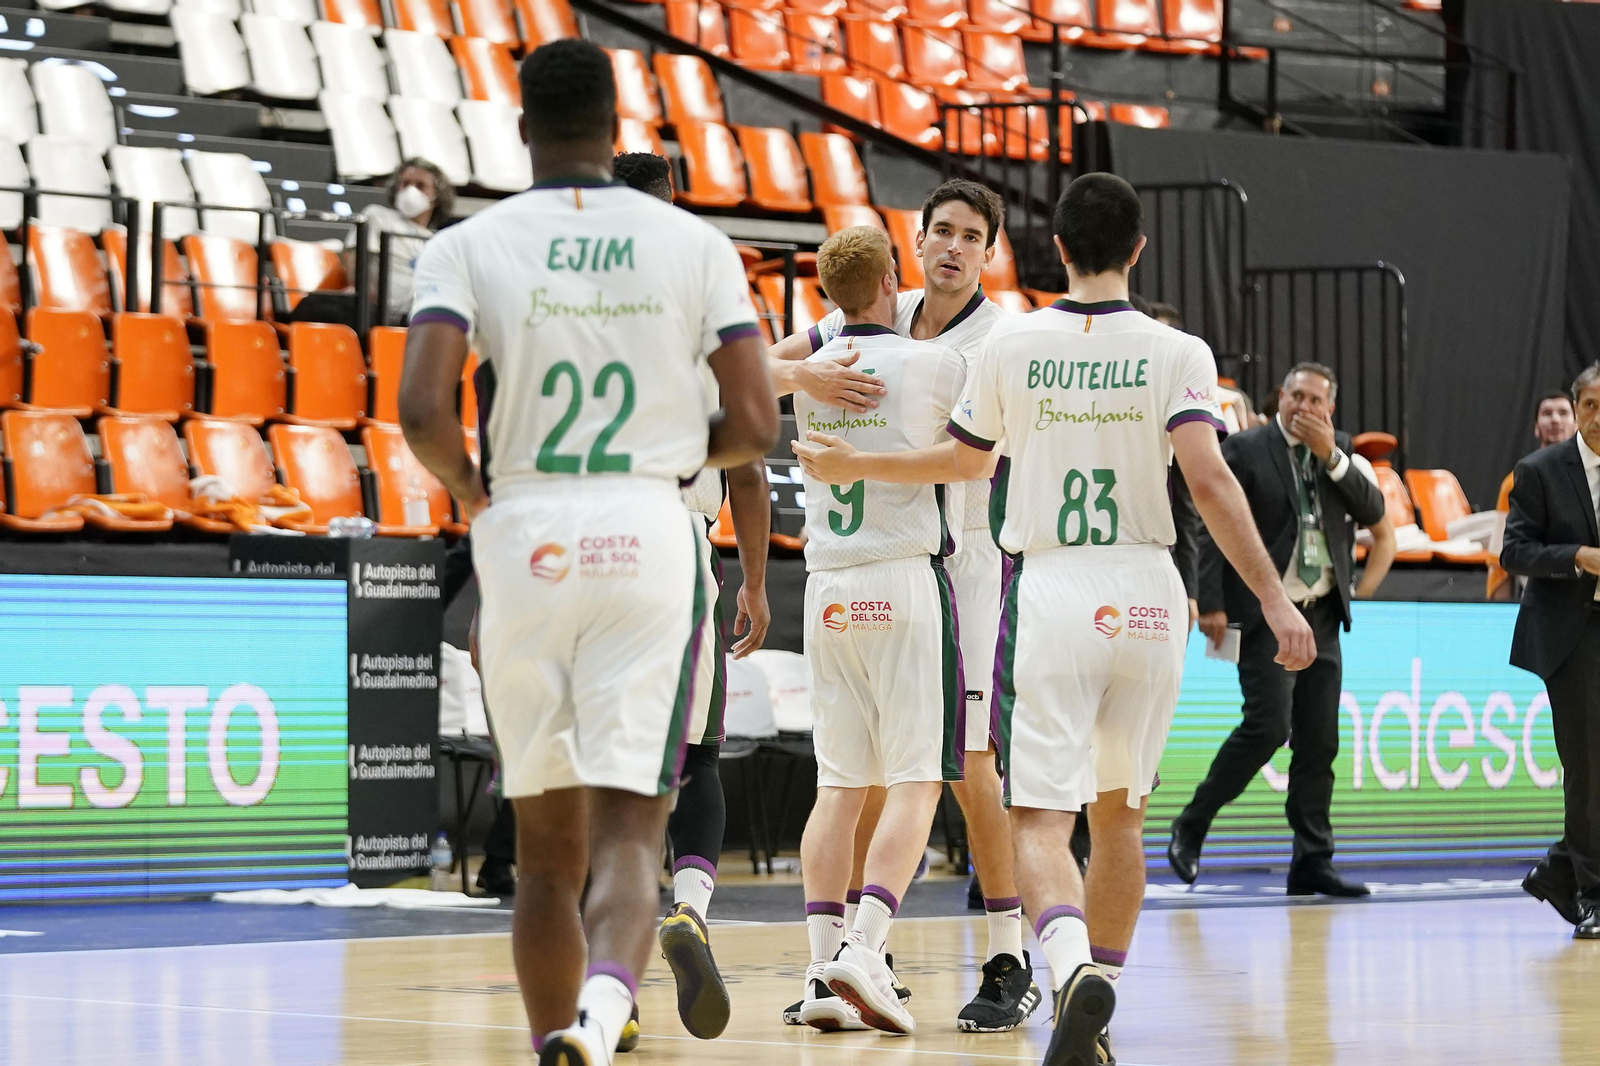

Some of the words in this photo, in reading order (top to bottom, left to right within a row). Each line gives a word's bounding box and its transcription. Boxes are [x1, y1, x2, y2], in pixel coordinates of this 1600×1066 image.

[547, 237, 635, 272] EJIM
[1027, 358, 1149, 390] BOUTEILLE
[536, 360, 636, 474] 22
[1056, 468, 1119, 546] 83
[579, 535, 642, 550] COSTA
[579, 553, 606, 566] DEL
[611, 551, 642, 564] SOL
[364, 562, 418, 582] Autopista
[419, 563, 436, 580] del
[362, 581, 440, 599] Guadalmedina
[850, 601, 893, 612] COSTA
[1128, 606, 1170, 620] COSTA
[851, 613, 871, 622] DEL
[871, 613, 893, 622] SOL
[1128, 619, 1151, 630] DEL
[1153, 621, 1170, 632] SOL
[361, 653, 416, 671] Autopista
[416, 653, 434, 670] del
[360, 671, 438, 689] Guadalmedina
[0, 683, 281, 809] ESTO
[358, 743, 412, 762] Autopista
[413, 743, 431, 760] del
[357, 762, 436, 780] Guadalmedina
[355, 833, 410, 852] Autopista
[410, 832, 429, 850] del
[354, 852, 434, 870] Guadalmedina
